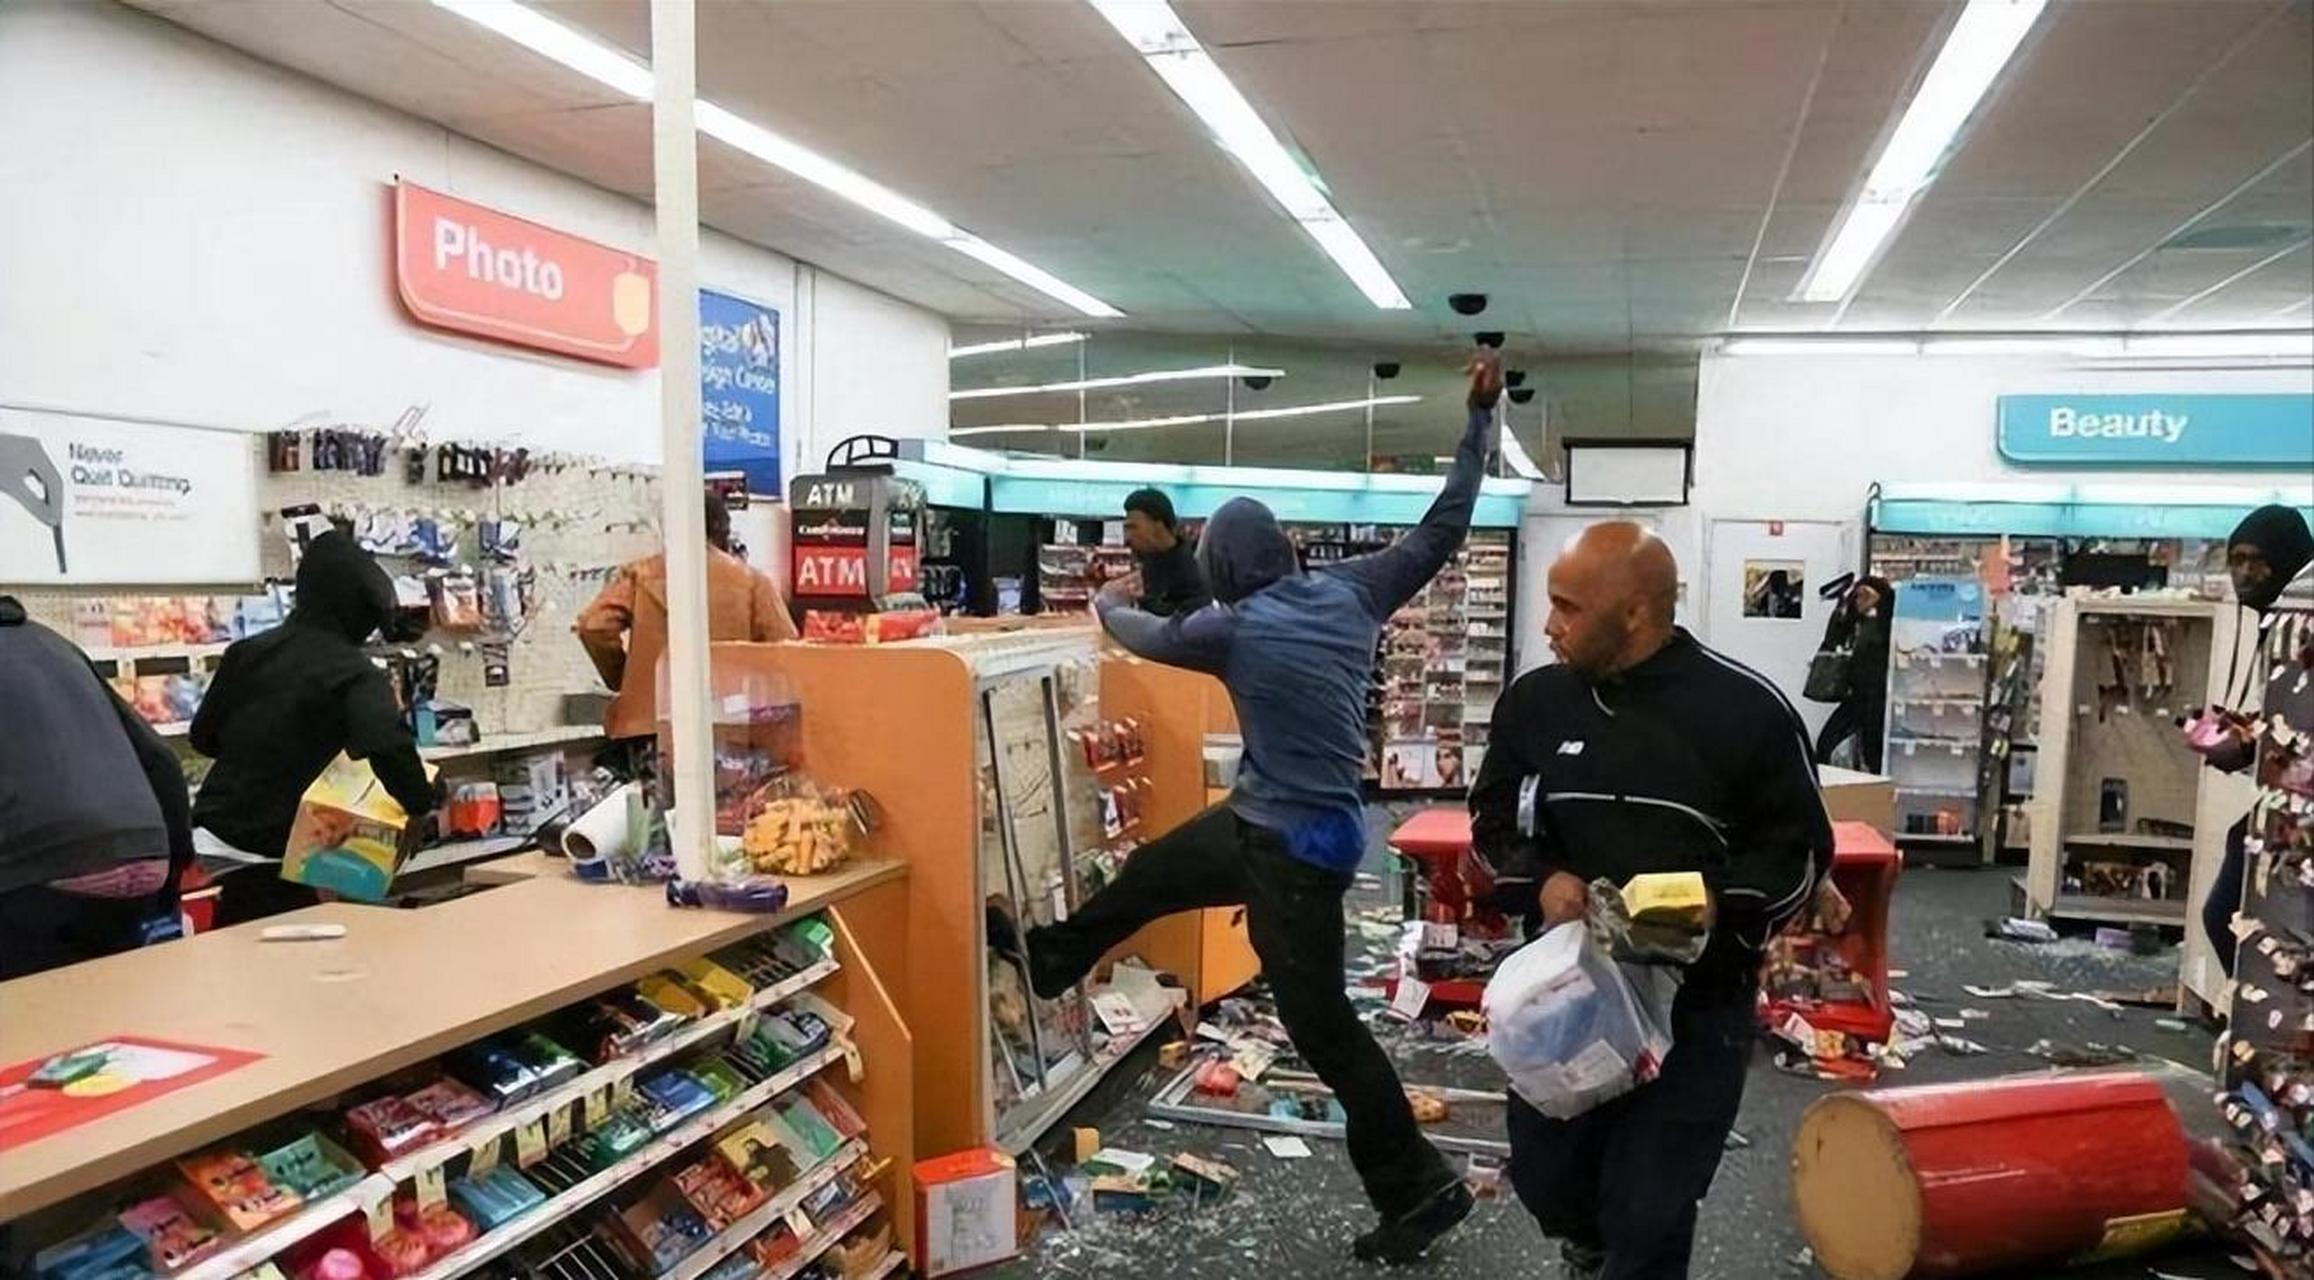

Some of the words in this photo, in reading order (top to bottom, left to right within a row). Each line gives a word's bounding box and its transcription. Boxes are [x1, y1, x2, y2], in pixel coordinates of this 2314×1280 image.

[434, 219, 563, 300] Photo
[2049, 407, 2188, 443] Beauty
[806, 482, 855, 507] ATM
[798, 555, 866, 586] ATM
